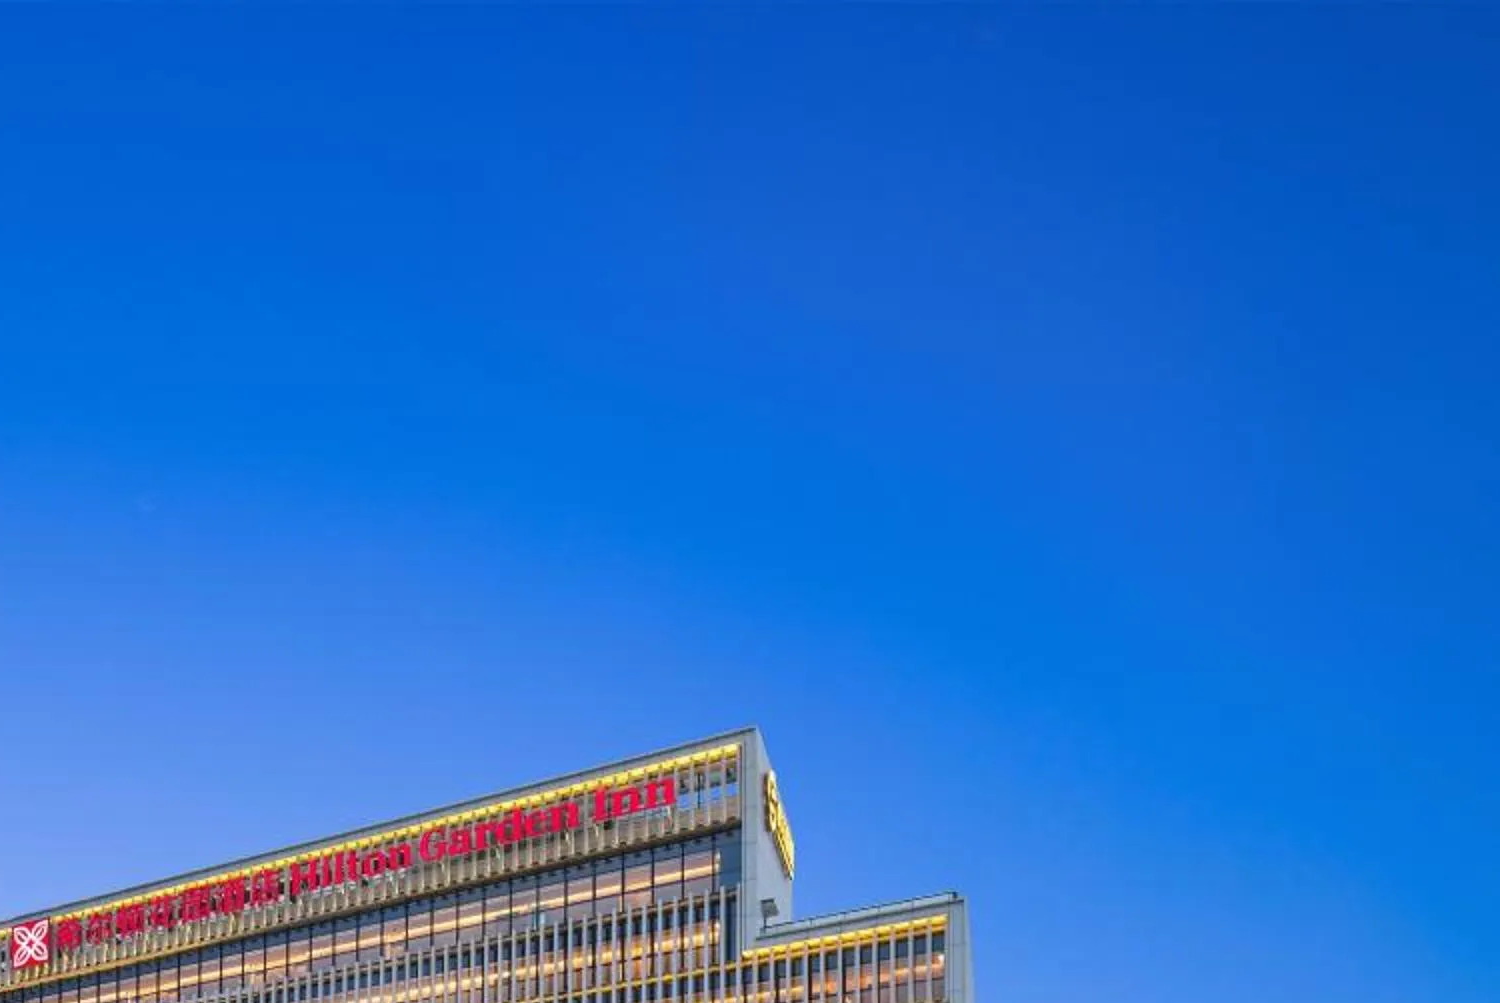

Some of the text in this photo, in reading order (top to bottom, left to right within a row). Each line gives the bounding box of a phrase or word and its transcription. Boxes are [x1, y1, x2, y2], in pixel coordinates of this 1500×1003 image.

[290, 843, 412, 896] Hilton
[419, 801, 580, 863] Garden
[592, 777, 676, 823] Inn
